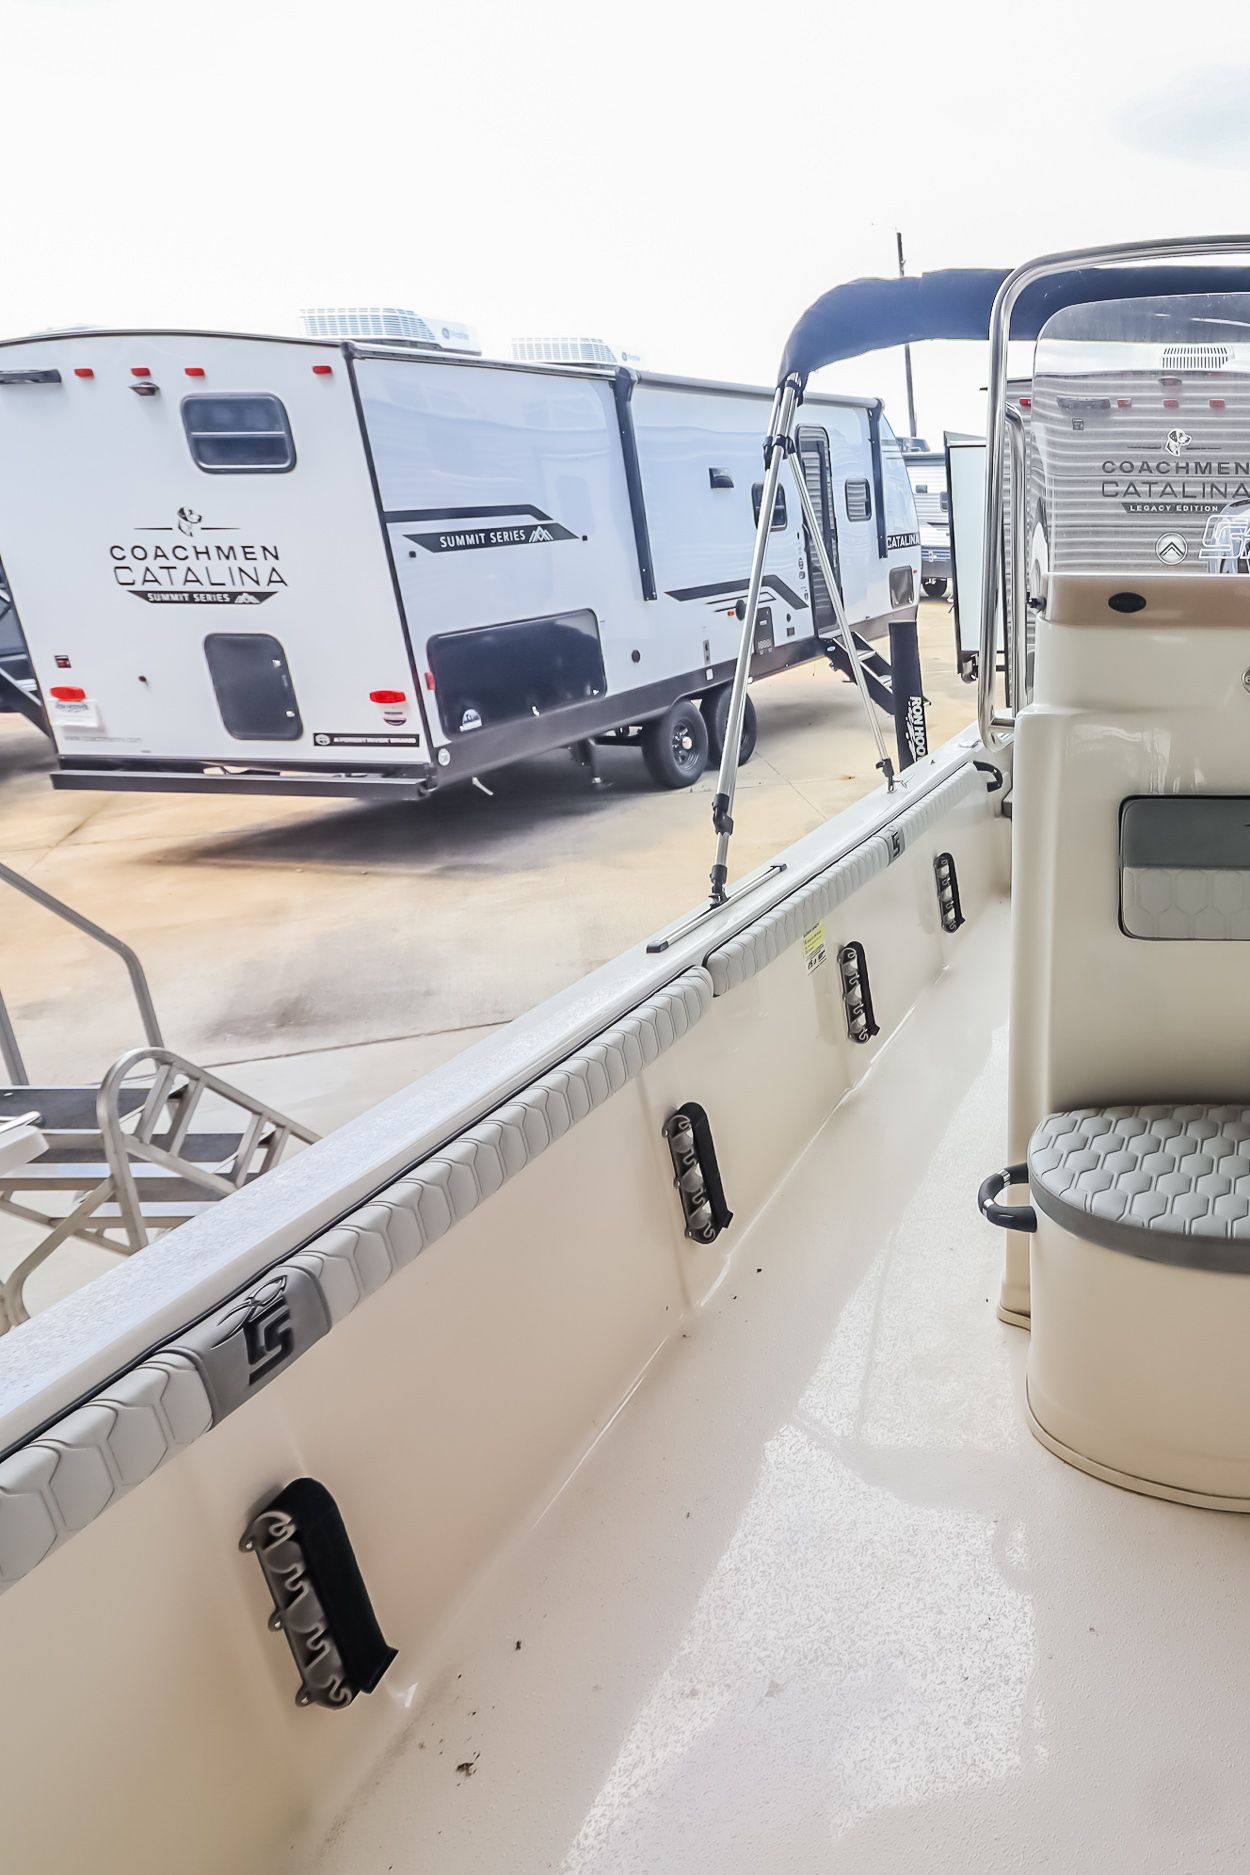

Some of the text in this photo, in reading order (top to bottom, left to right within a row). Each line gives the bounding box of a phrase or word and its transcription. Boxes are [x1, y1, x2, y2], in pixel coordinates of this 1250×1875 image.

[1101, 461, 1250, 475] COACHMEN
[1101, 481, 1250, 498] CATALINA
[440, 530, 526, 548] SUMMIT SERIES
[110, 545, 280, 561] COACHMEN
[114, 566, 288, 587] CATALINA
[147, 593, 230, 602] SUMMIT SERIES
[909, 696, 926, 759] RON HOO
